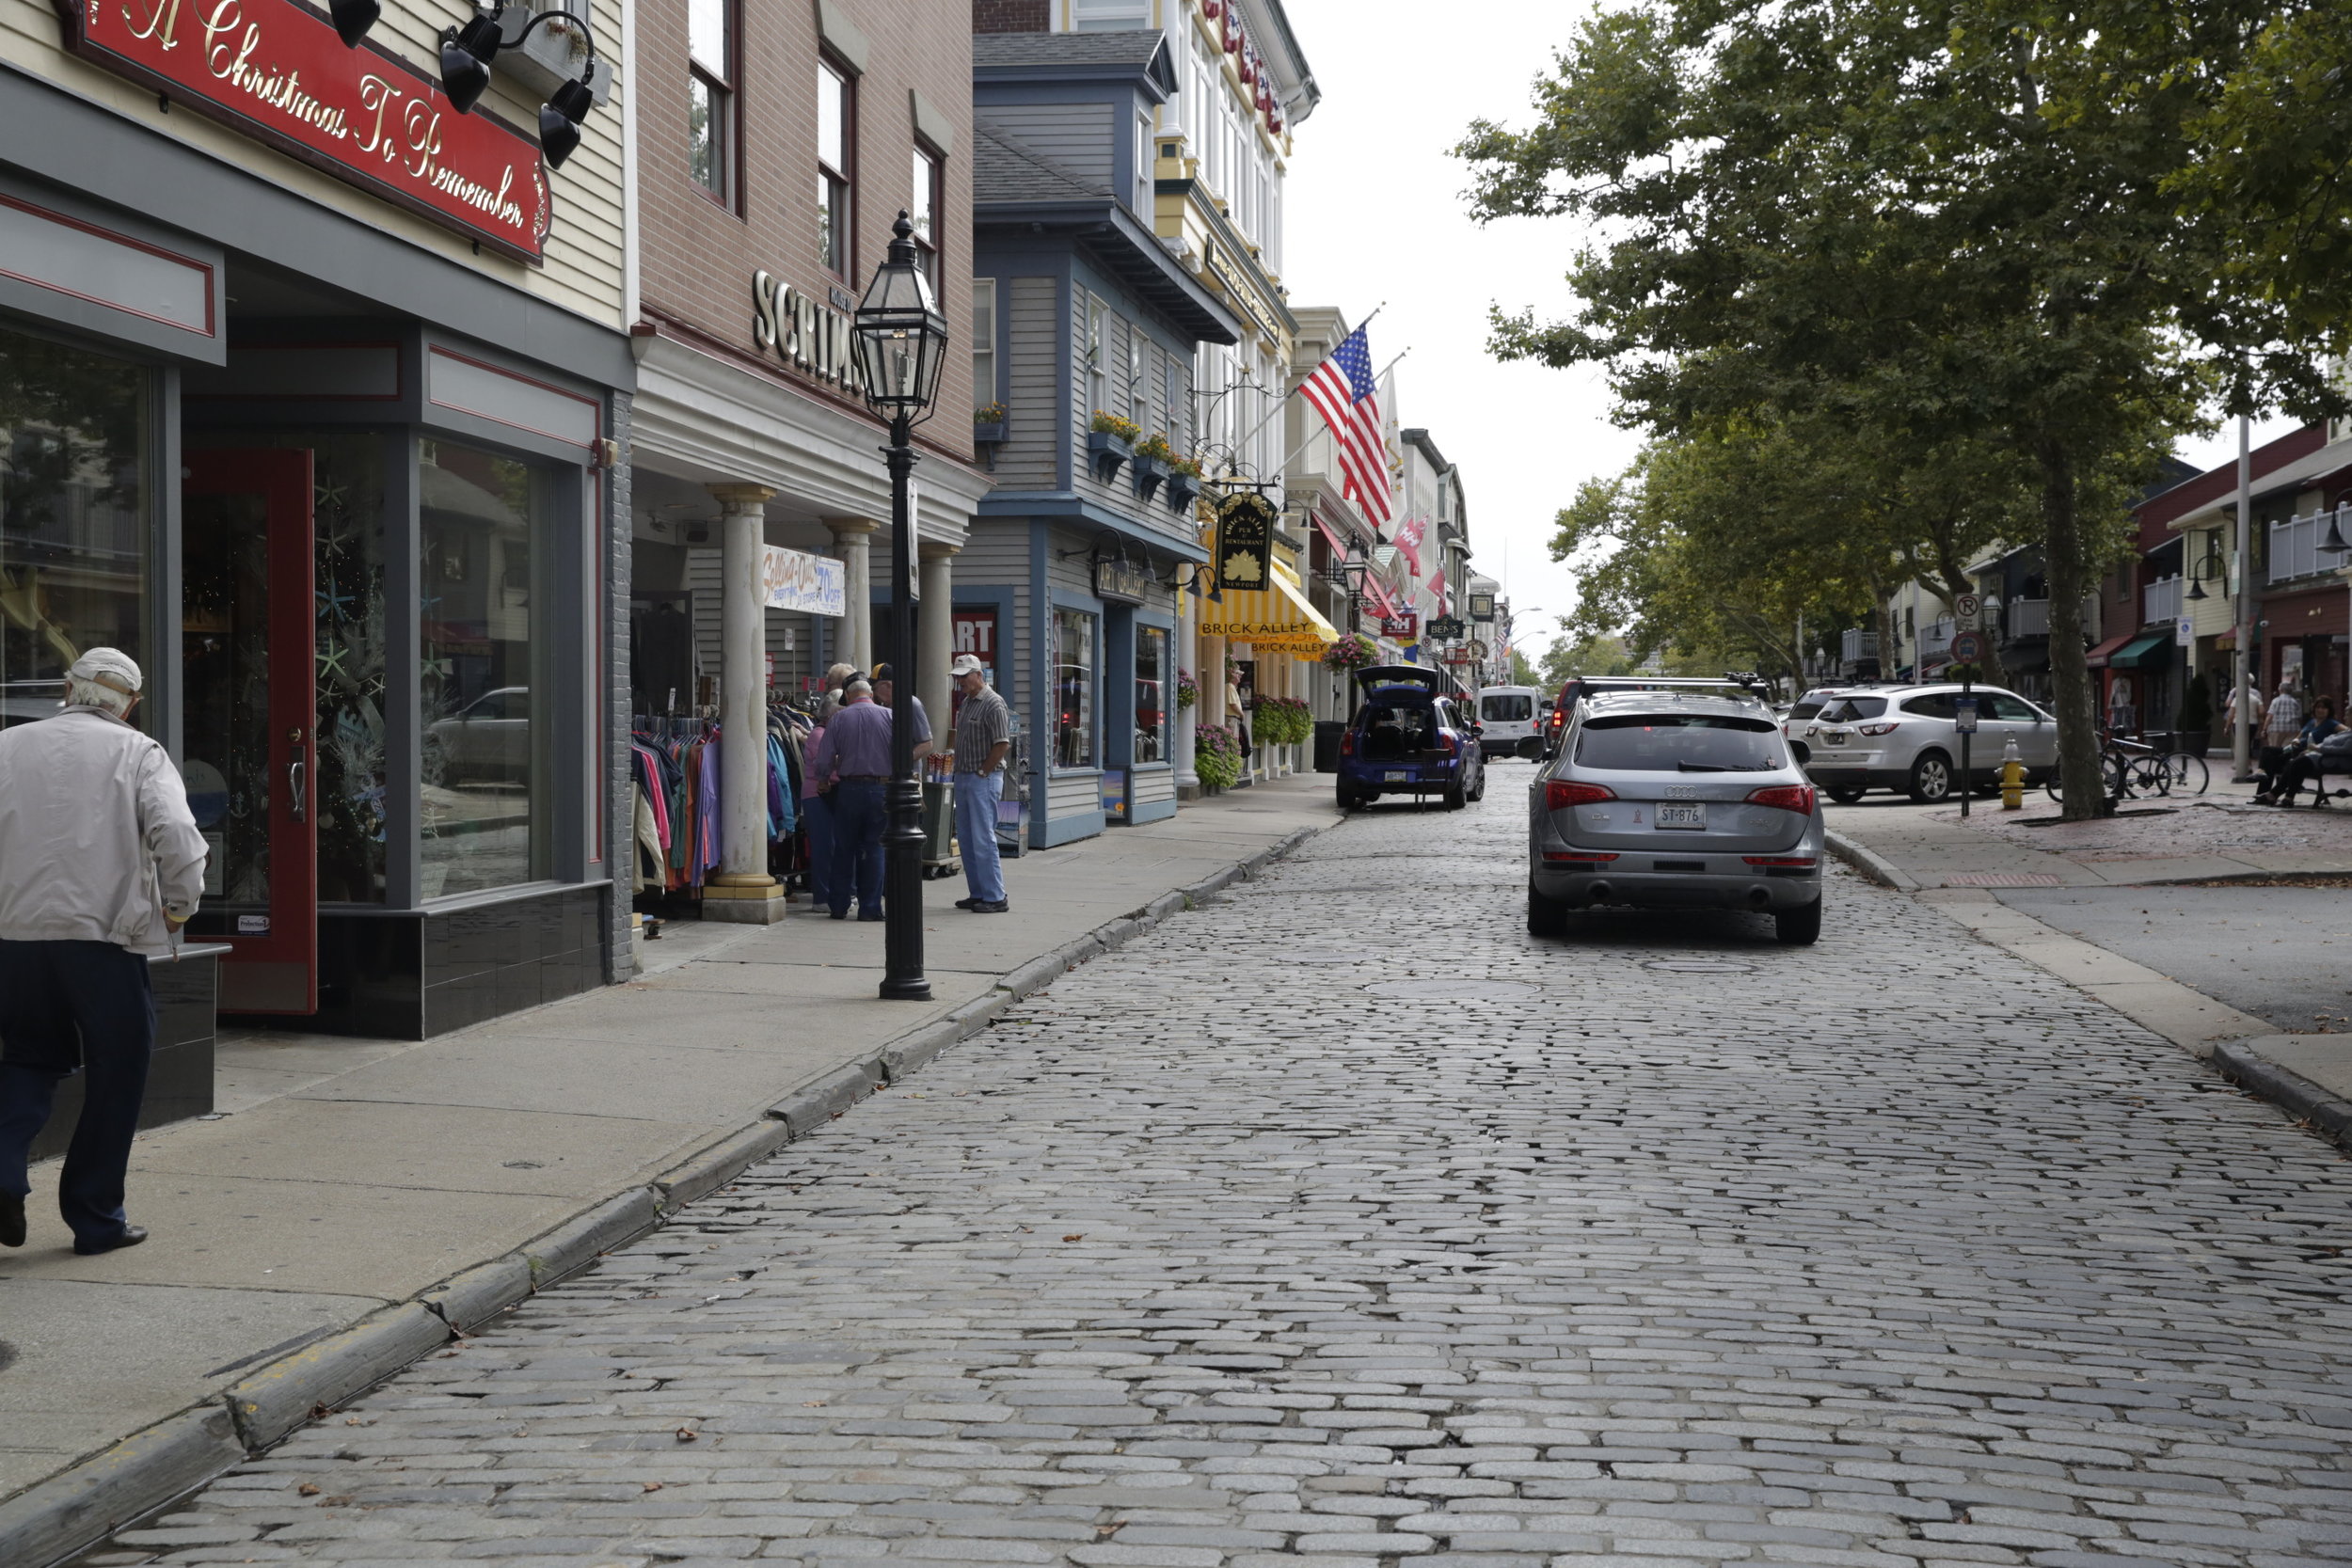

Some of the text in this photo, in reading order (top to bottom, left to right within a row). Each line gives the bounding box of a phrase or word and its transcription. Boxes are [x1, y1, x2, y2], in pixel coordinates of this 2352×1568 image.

[193, 0, 348, 139] Christmas
[354, 73, 402, 163] To
[404, 98, 524, 229] Remember
[1226, 515, 1264, 536] BRICK ALLEY
[830, 589, 840, 602] OFF
[1202, 622, 1309, 634] BRICK ALLEY
[1251, 642, 1326, 653] BRICK ALLEY
